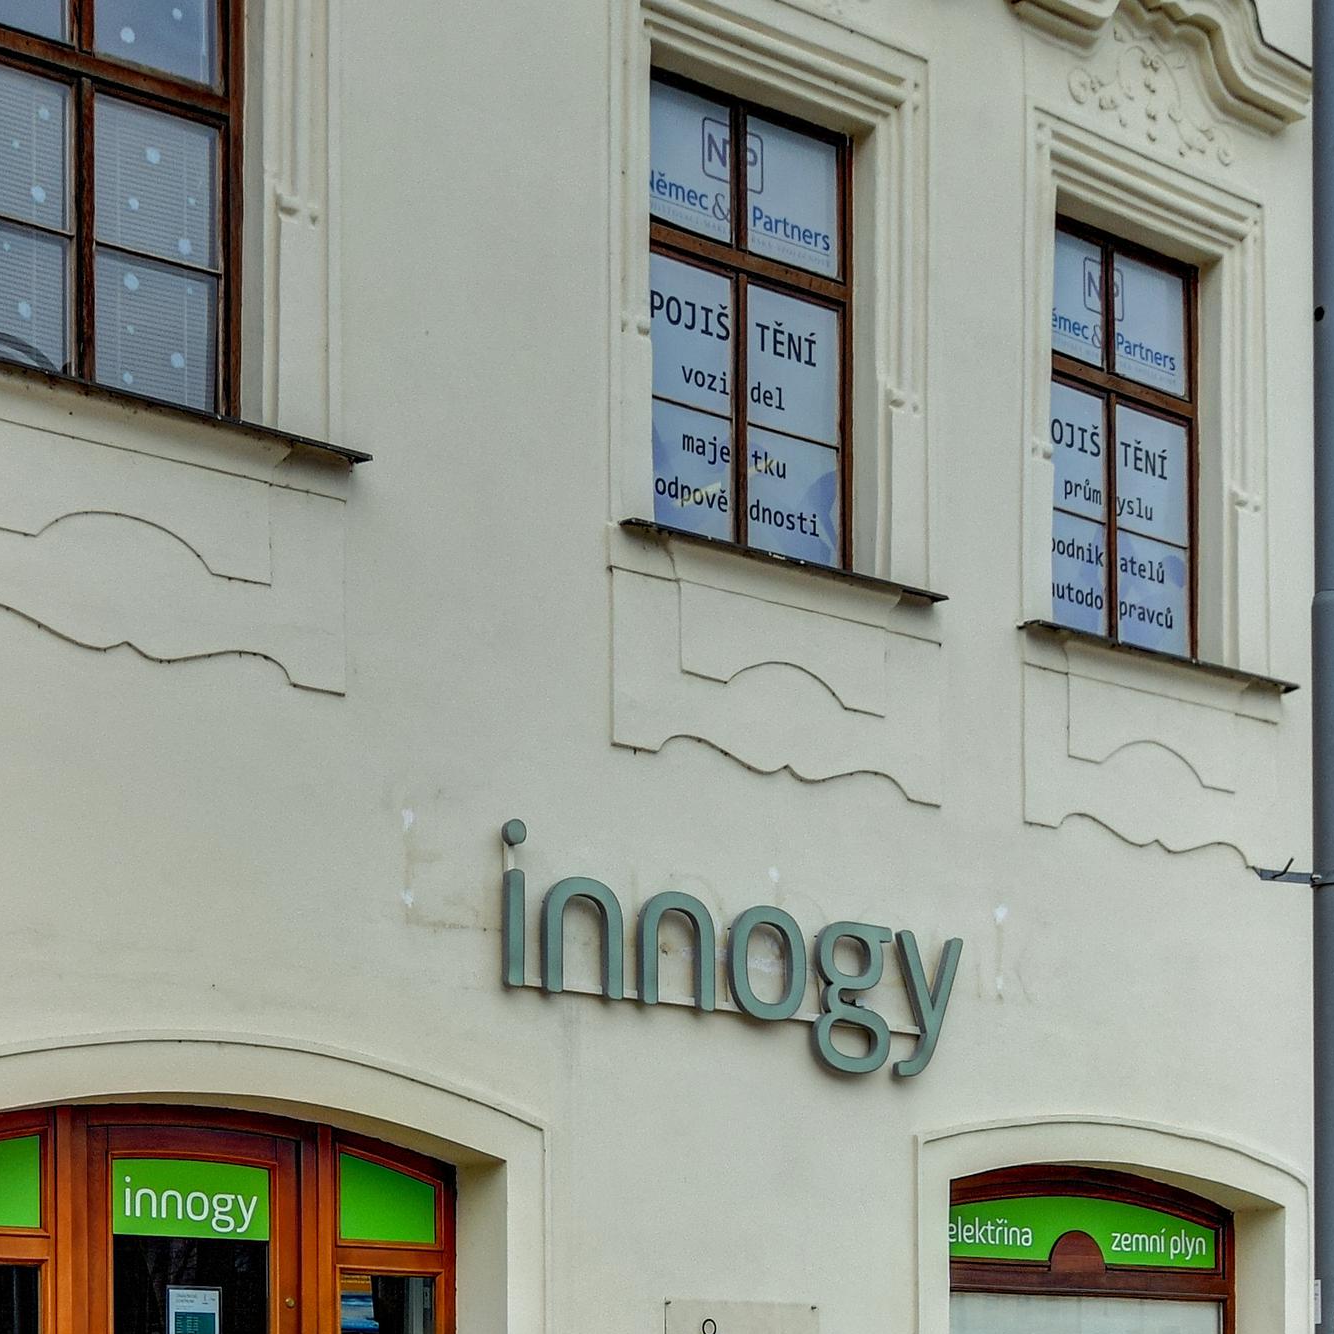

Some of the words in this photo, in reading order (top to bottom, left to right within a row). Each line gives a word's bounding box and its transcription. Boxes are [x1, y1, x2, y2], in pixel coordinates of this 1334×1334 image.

[752, 206, 831, 252] Partners
[1052, 307, 1089, 340] ěmec
[1116, 332, 1176, 371] Partners
[1051, 418, 1101, 458] OJIŠ
[1052, 582, 1104, 611] utodo
[501, 818, 963, 1078] innogy
[124, 1175, 258, 1233] innogy
[948, 1216, 1033, 1248] elektřina
[1110, 1228, 1165, 1253] zemní
[1169, 1229, 1207, 1261] plyn
